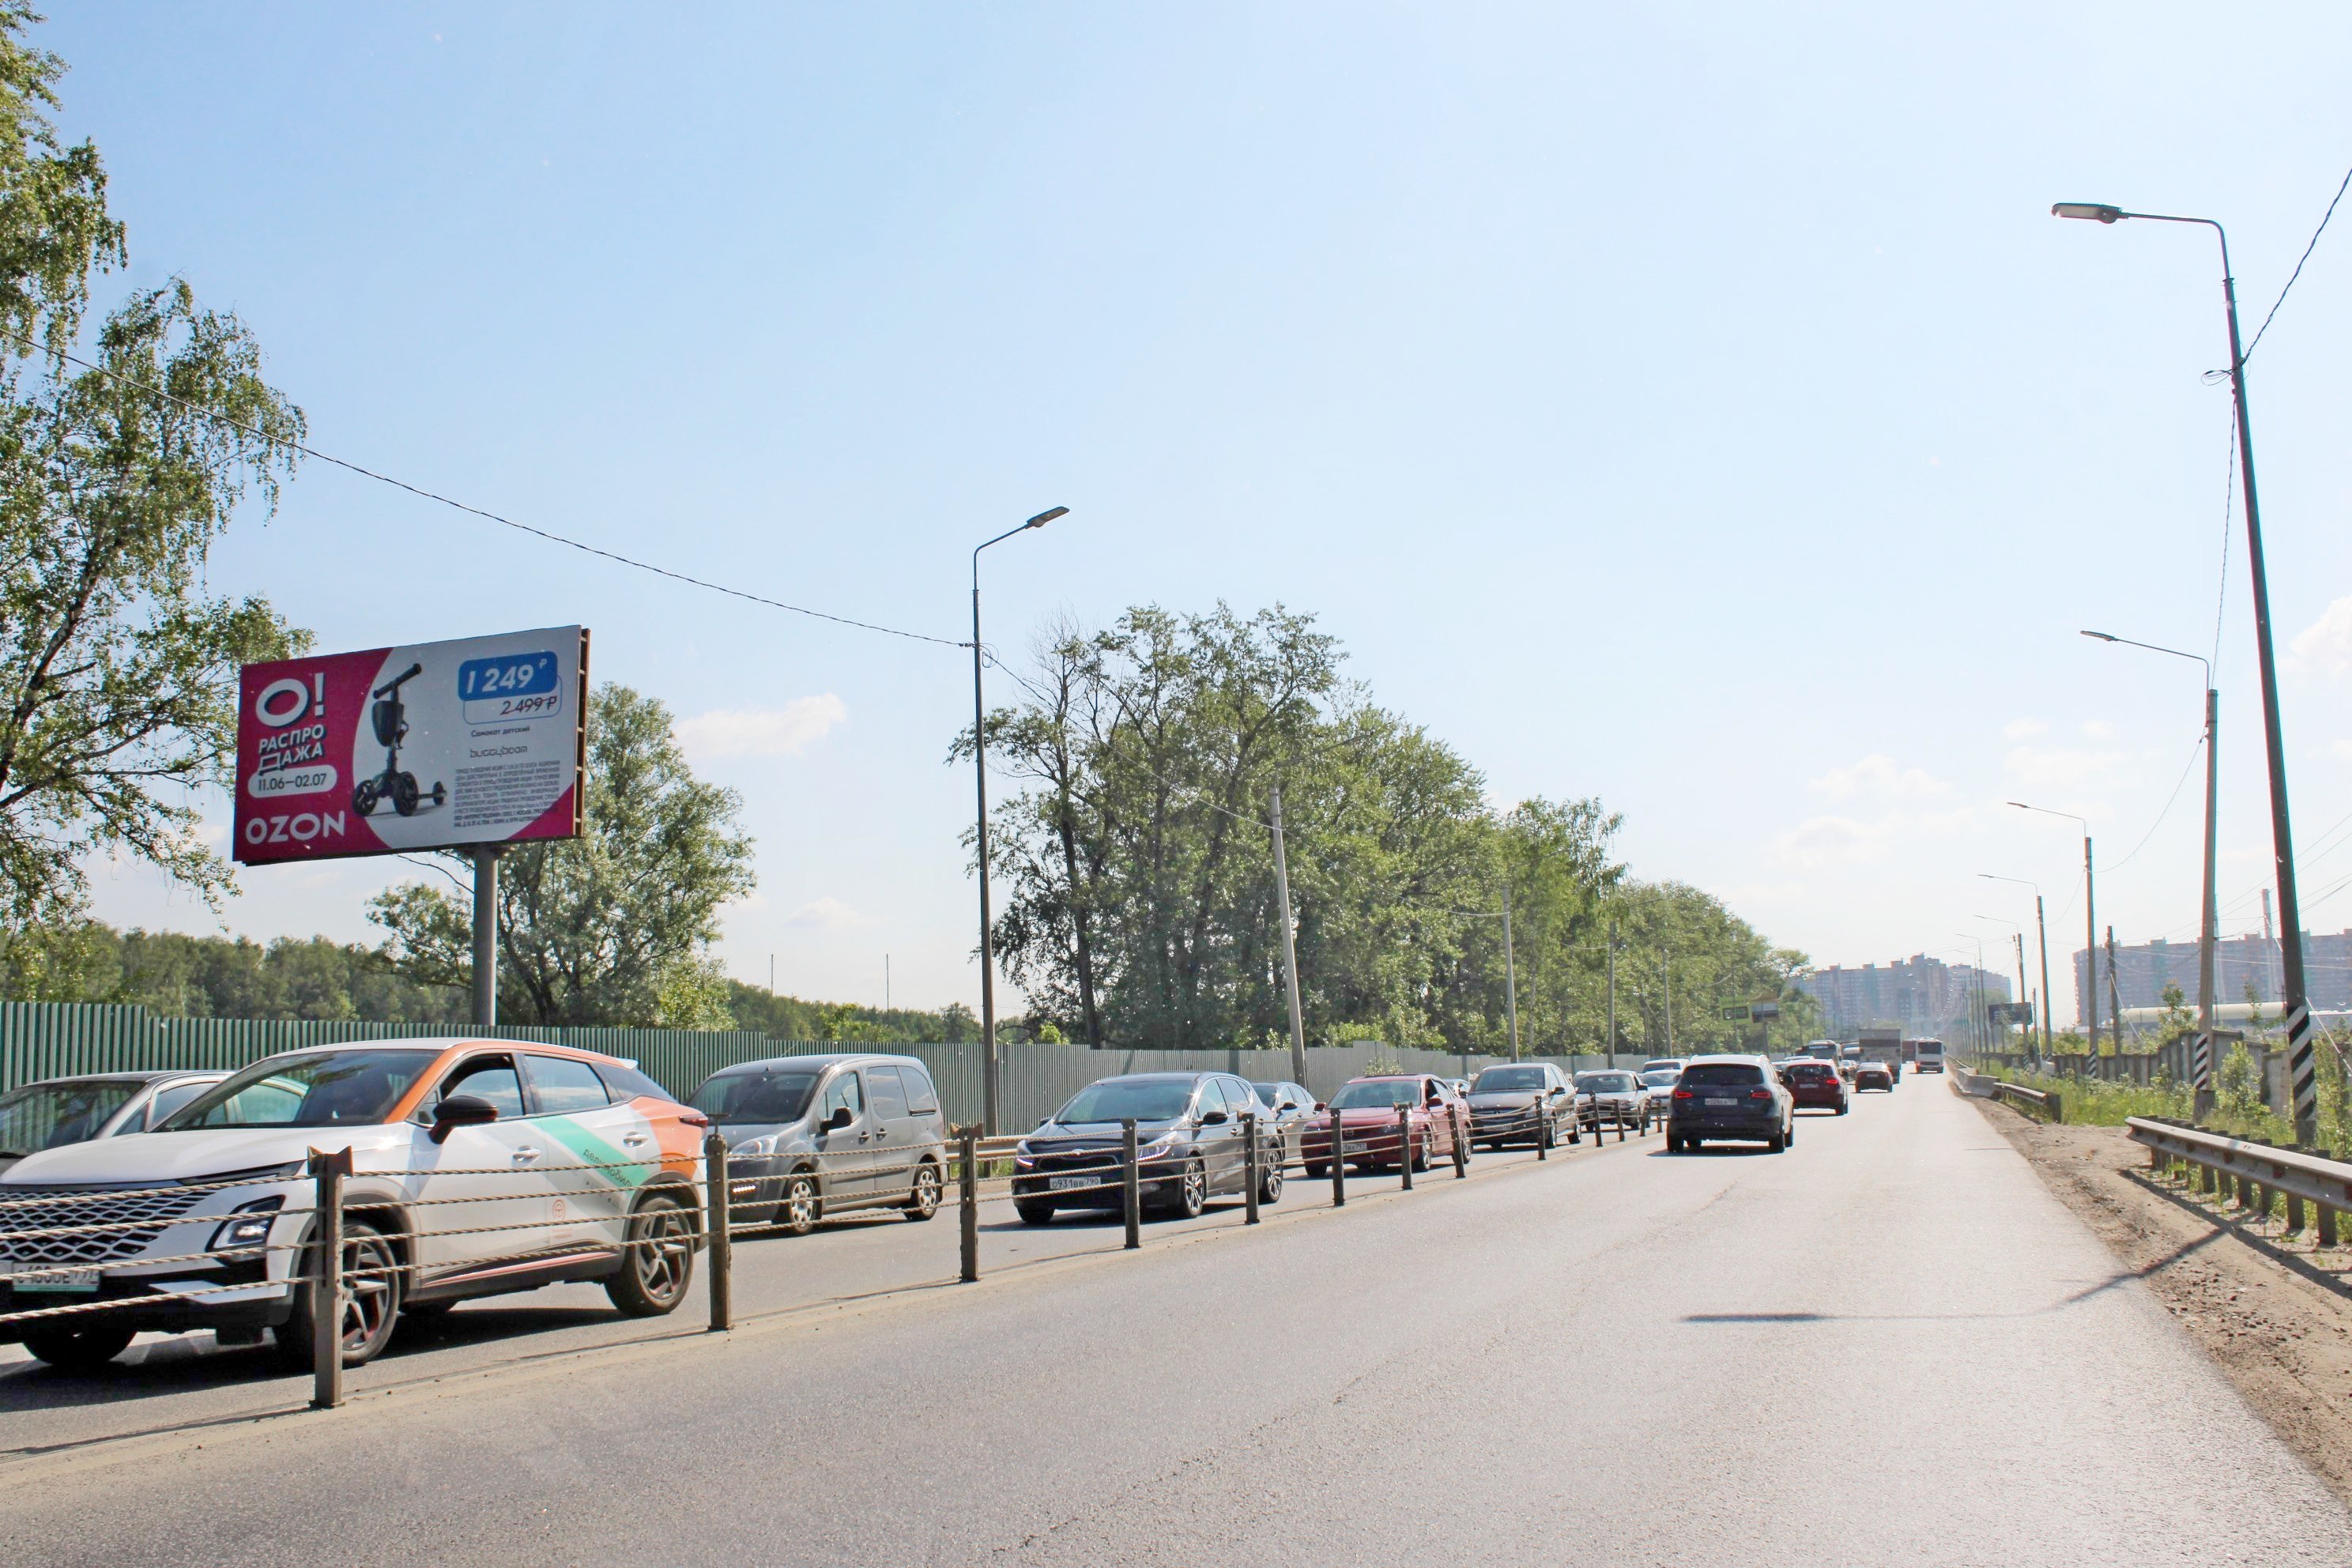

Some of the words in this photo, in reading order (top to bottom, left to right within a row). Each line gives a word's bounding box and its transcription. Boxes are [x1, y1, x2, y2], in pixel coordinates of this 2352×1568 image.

[256, 672, 326, 727] О!
[259, 723, 326, 755] РАСПРО
[470, 729, 501, 737] Самокат
[502, 726, 530, 736] детский
[258, 742, 324, 775] ДАЖА
[244, 810, 345, 844] OZON
